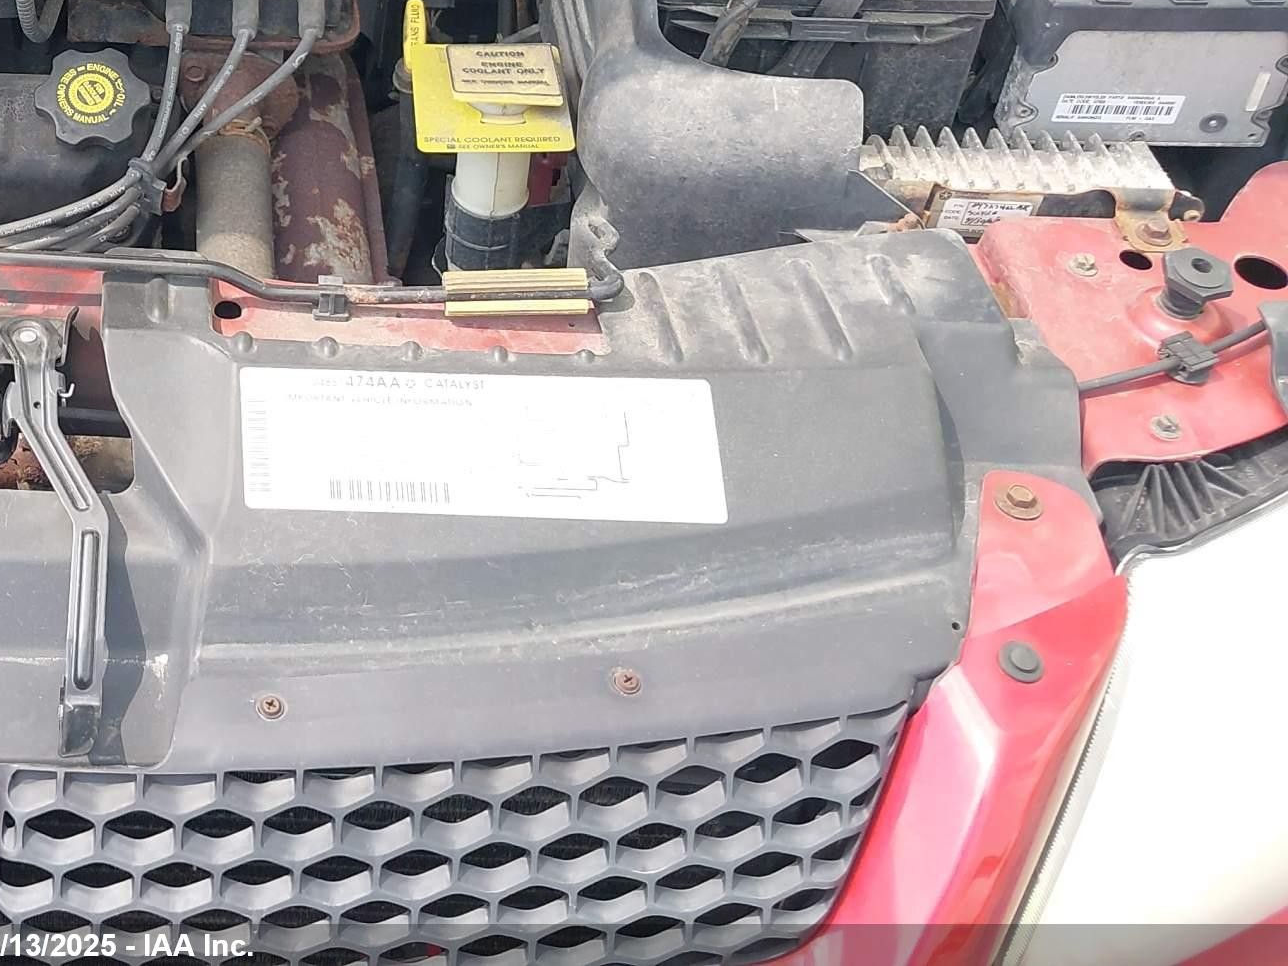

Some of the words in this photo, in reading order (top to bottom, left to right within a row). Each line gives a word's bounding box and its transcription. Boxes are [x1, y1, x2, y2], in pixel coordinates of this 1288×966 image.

[476, 50, 525, 58] CAUTION
[61, 68, 77, 85] SEE
[86, 63, 119, 81] ENGINE
[113, 93, 126, 107] OIL
[56, 84, 74, 116] OWNERS
[73, 113, 110, 124] MANUAL
[423, 377, 485, 391] CATALYST
